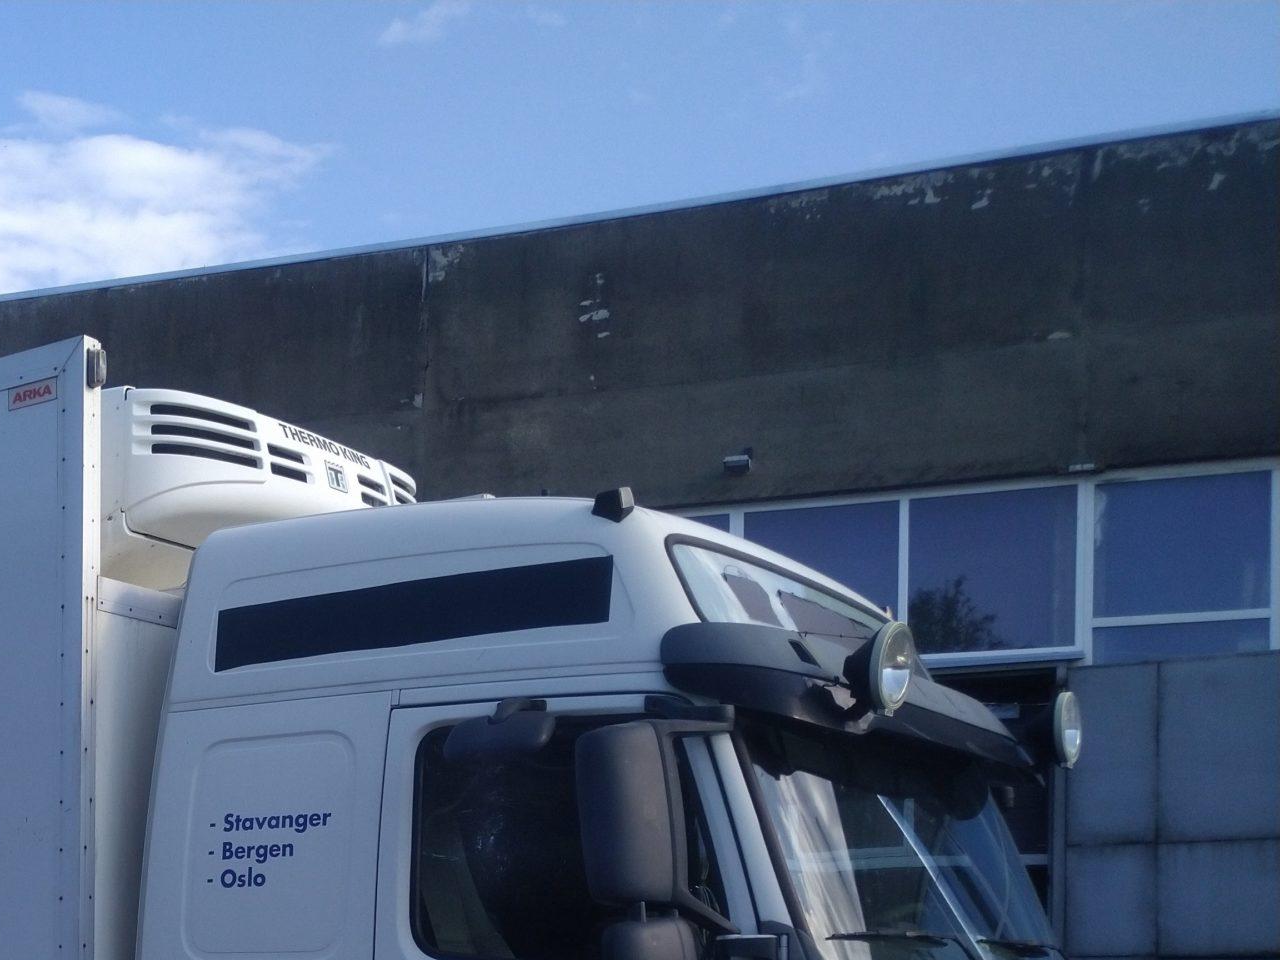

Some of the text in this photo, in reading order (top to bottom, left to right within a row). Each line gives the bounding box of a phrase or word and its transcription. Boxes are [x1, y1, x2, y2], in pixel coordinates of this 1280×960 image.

[12, 383, 52, 405] ARKA
[278, 422, 371, 470] THERMO KING
[222, 812, 332, 833] Stavanger
[221, 841, 295, 864] Bergen
[220, 867, 266, 889] Oslo
